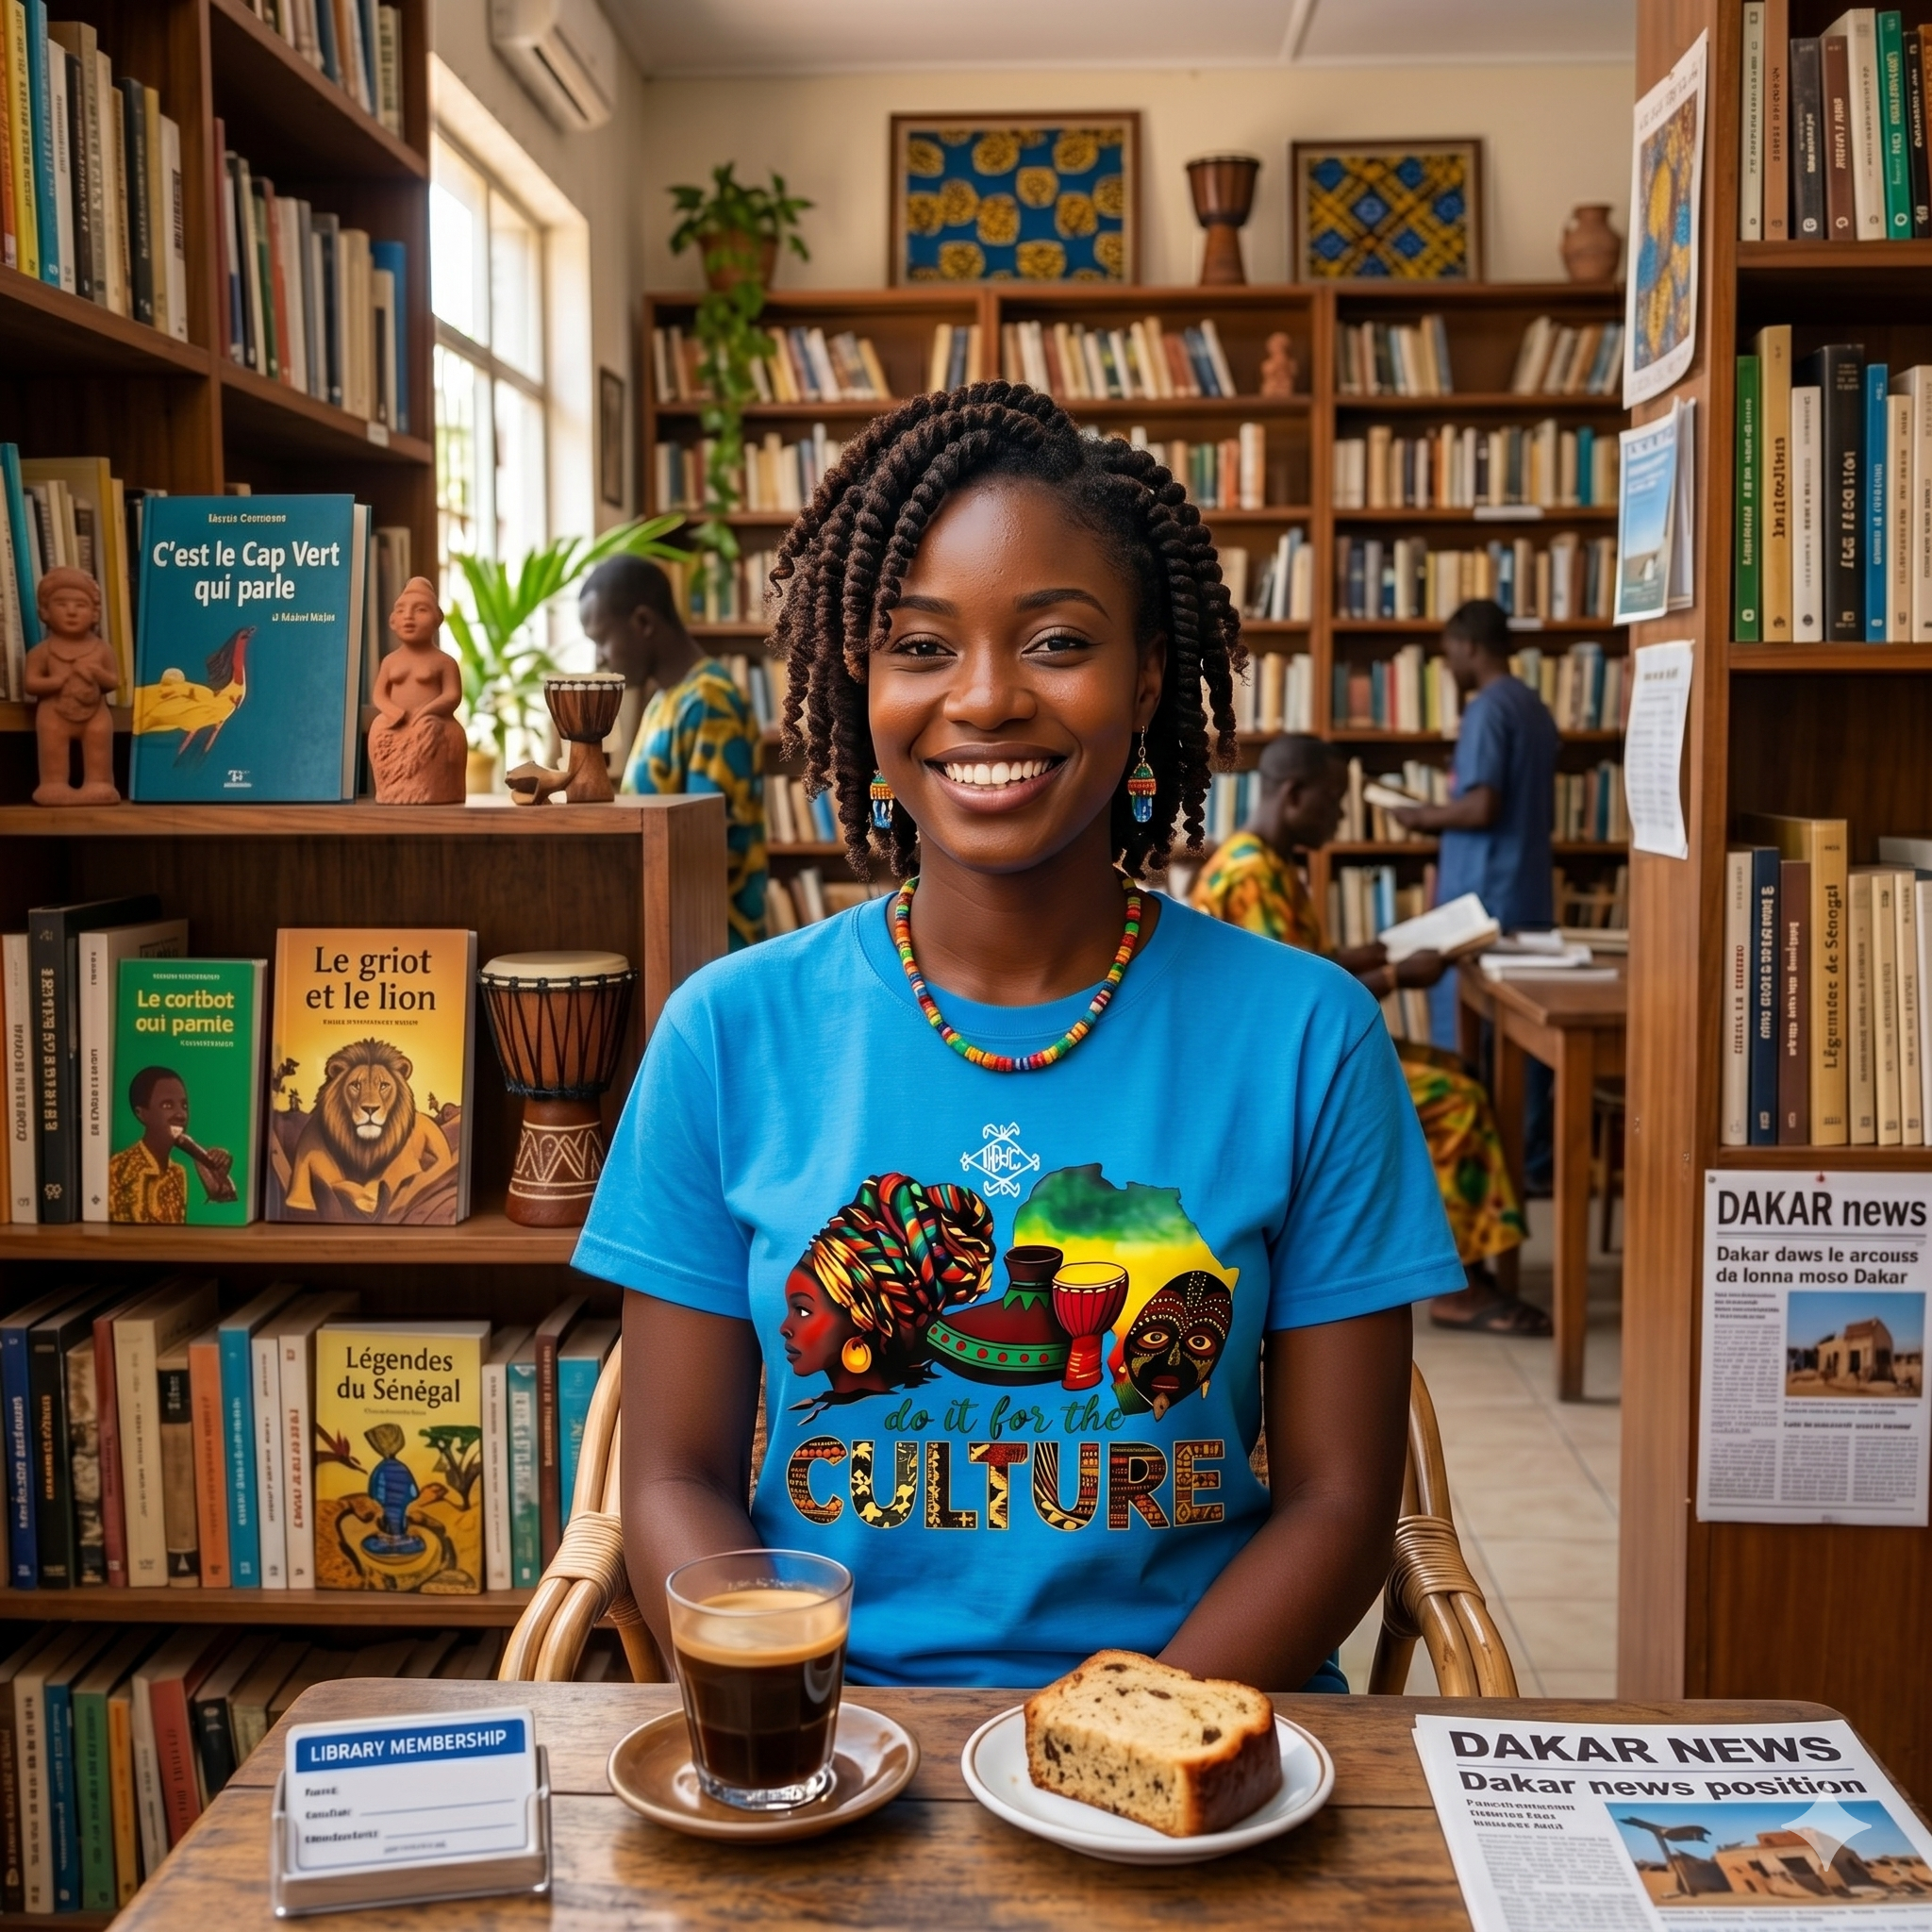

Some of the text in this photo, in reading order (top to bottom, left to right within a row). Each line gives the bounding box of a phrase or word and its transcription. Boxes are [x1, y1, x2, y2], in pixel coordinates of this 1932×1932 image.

[154, 541, 340, 573] C'est le Cap Vert
[194, 574, 294, 607] qui parle
[315, 946, 432, 982] Le griot
[138, 990, 159, 1008] Le
[306, 982, 436, 1010] et le lion
[1717, 1190, 1927, 1227] DAKAR news
[1716, 1245, 1770, 1263] Dakar
[1774, 1245, 1824, 1263] daws
[1828, 1245, 1844, 1263] le
[1854, 1268, 1908, 1284] Dakar
[345, 1346, 454, 1376] Légendes
[337, 1375, 460, 1409] du Sénégal
[884, 1394, 1126, 1441] do it for the
[785, 1435, 1225, 1532] CULTURE
[310, 1729, 507, 1762] LIBRARY MEMBERSHIP
[1448, 1730, 1842, 1764] DAKAR NEWS
[1457, 1771, 1869, 1801] Dakar news position
